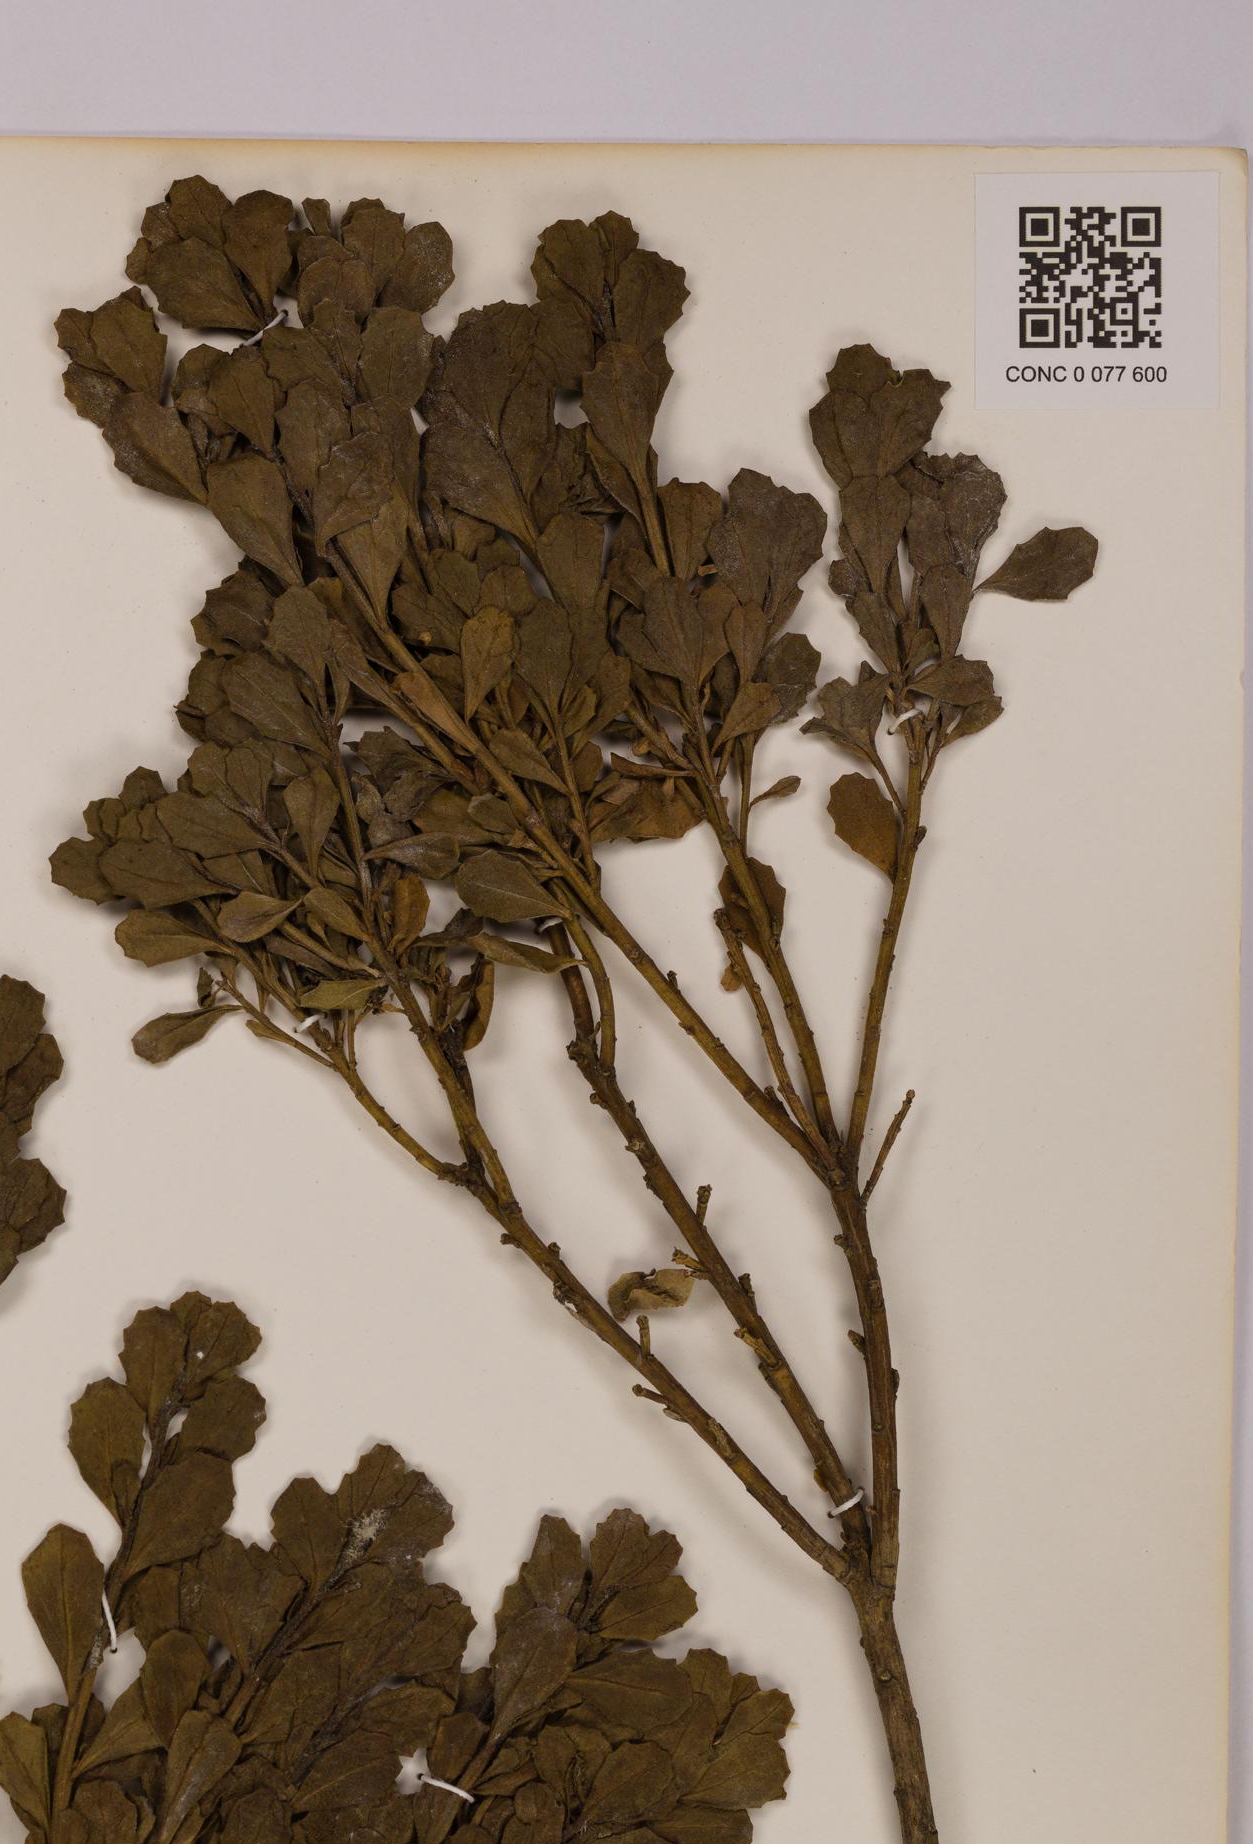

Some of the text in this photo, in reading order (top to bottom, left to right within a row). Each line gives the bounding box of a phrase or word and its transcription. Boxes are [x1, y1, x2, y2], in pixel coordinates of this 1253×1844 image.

[1005, 365, 1168, 383] CONC 0 077 600
